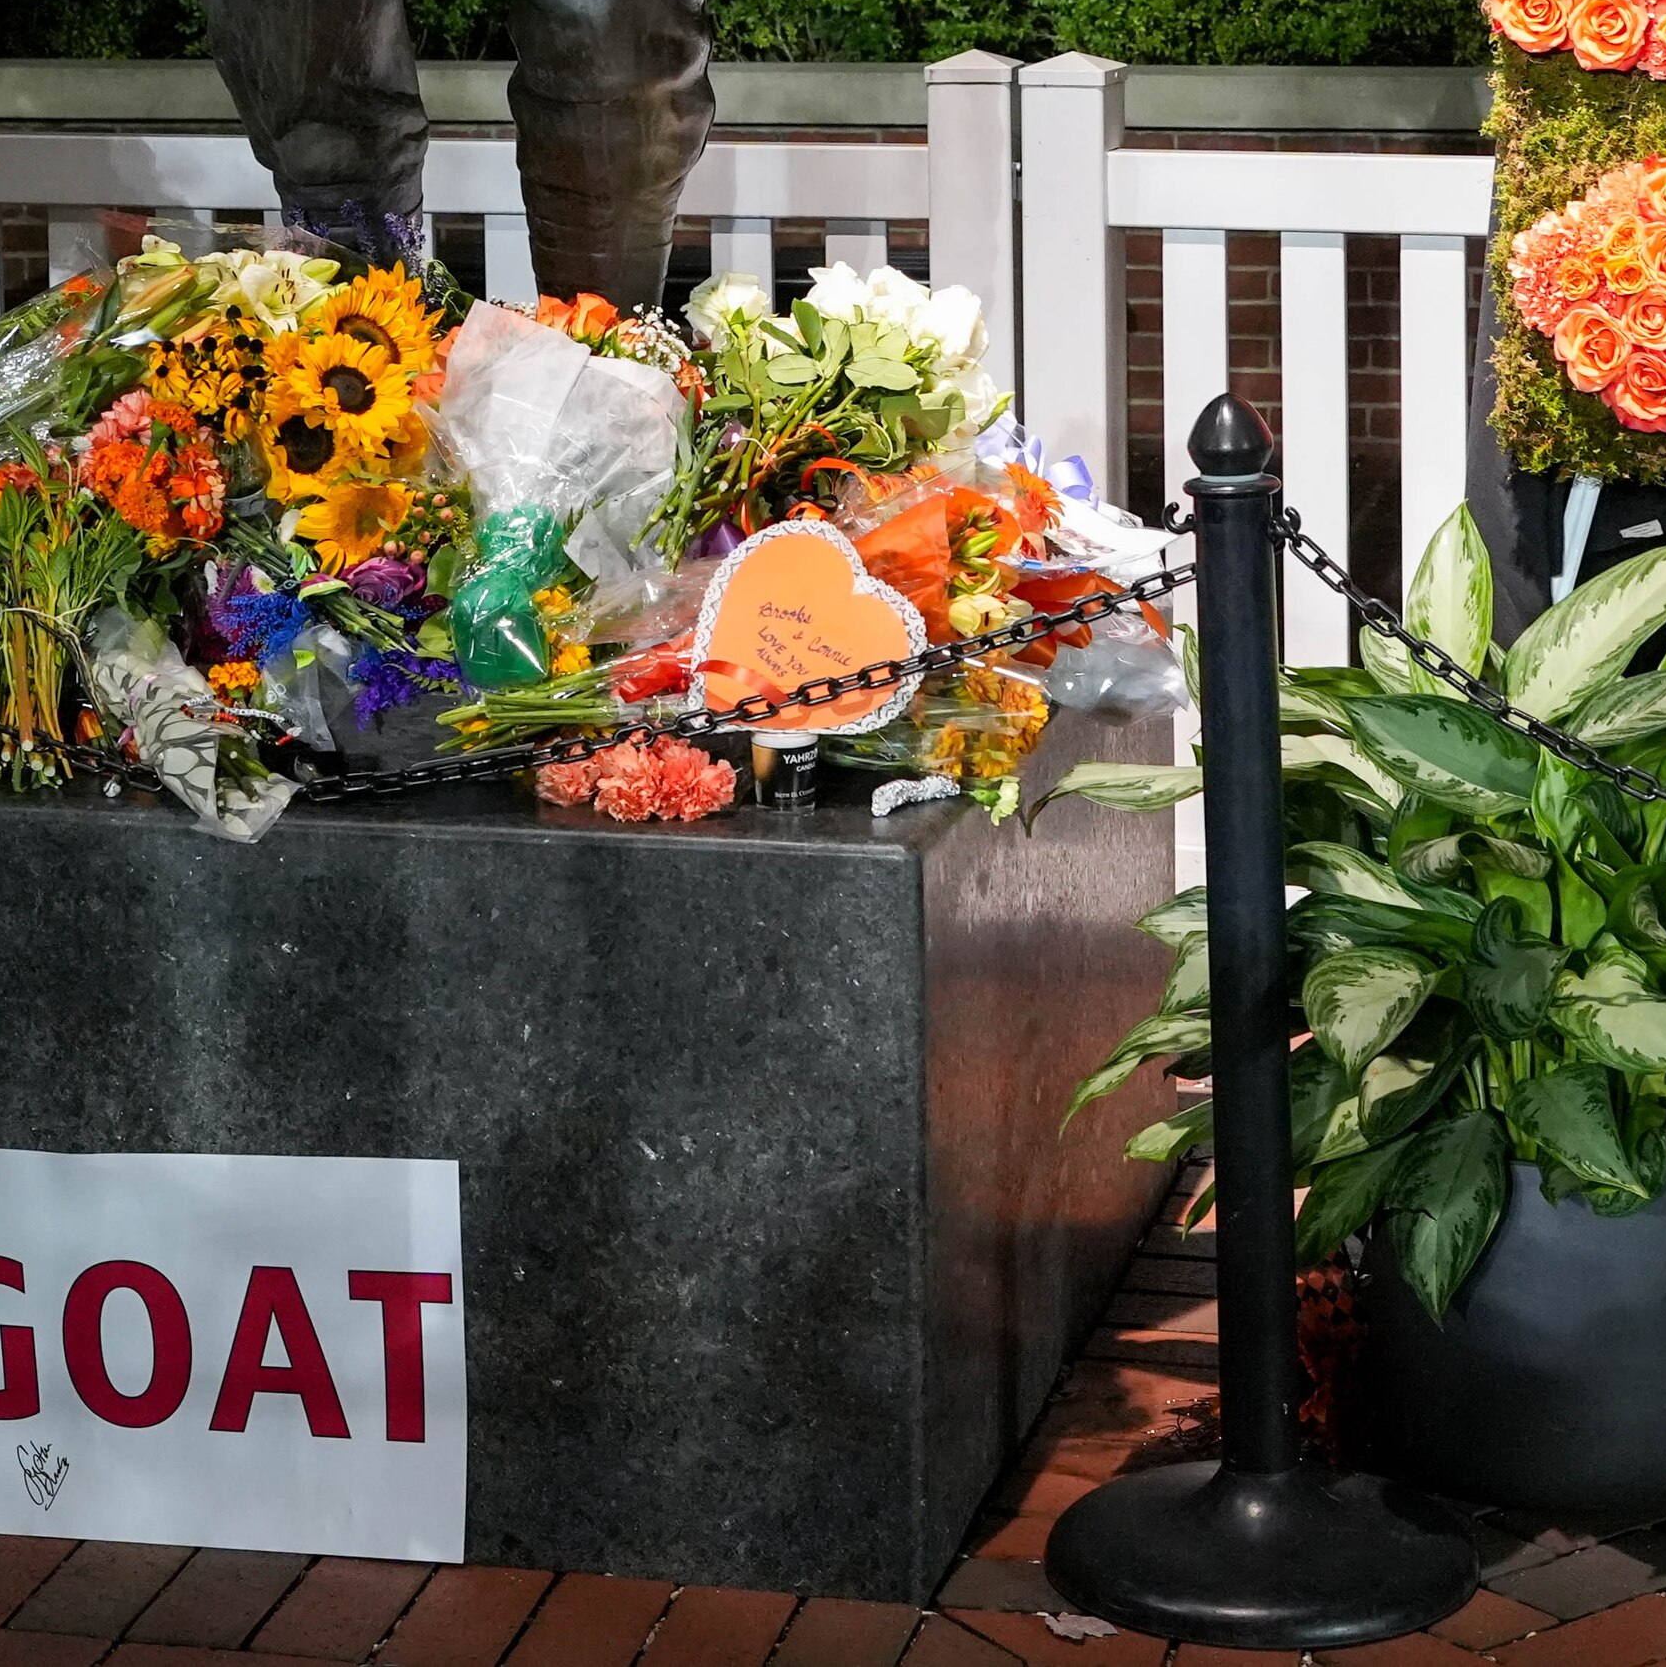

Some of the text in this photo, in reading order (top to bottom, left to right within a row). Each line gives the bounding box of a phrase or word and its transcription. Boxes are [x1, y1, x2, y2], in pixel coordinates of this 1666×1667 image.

[758, 601, 812, 624] Brooks
[756, 647, 788, 678] ALWAYS
[758, 625, 811, 676] LOVE YOU
